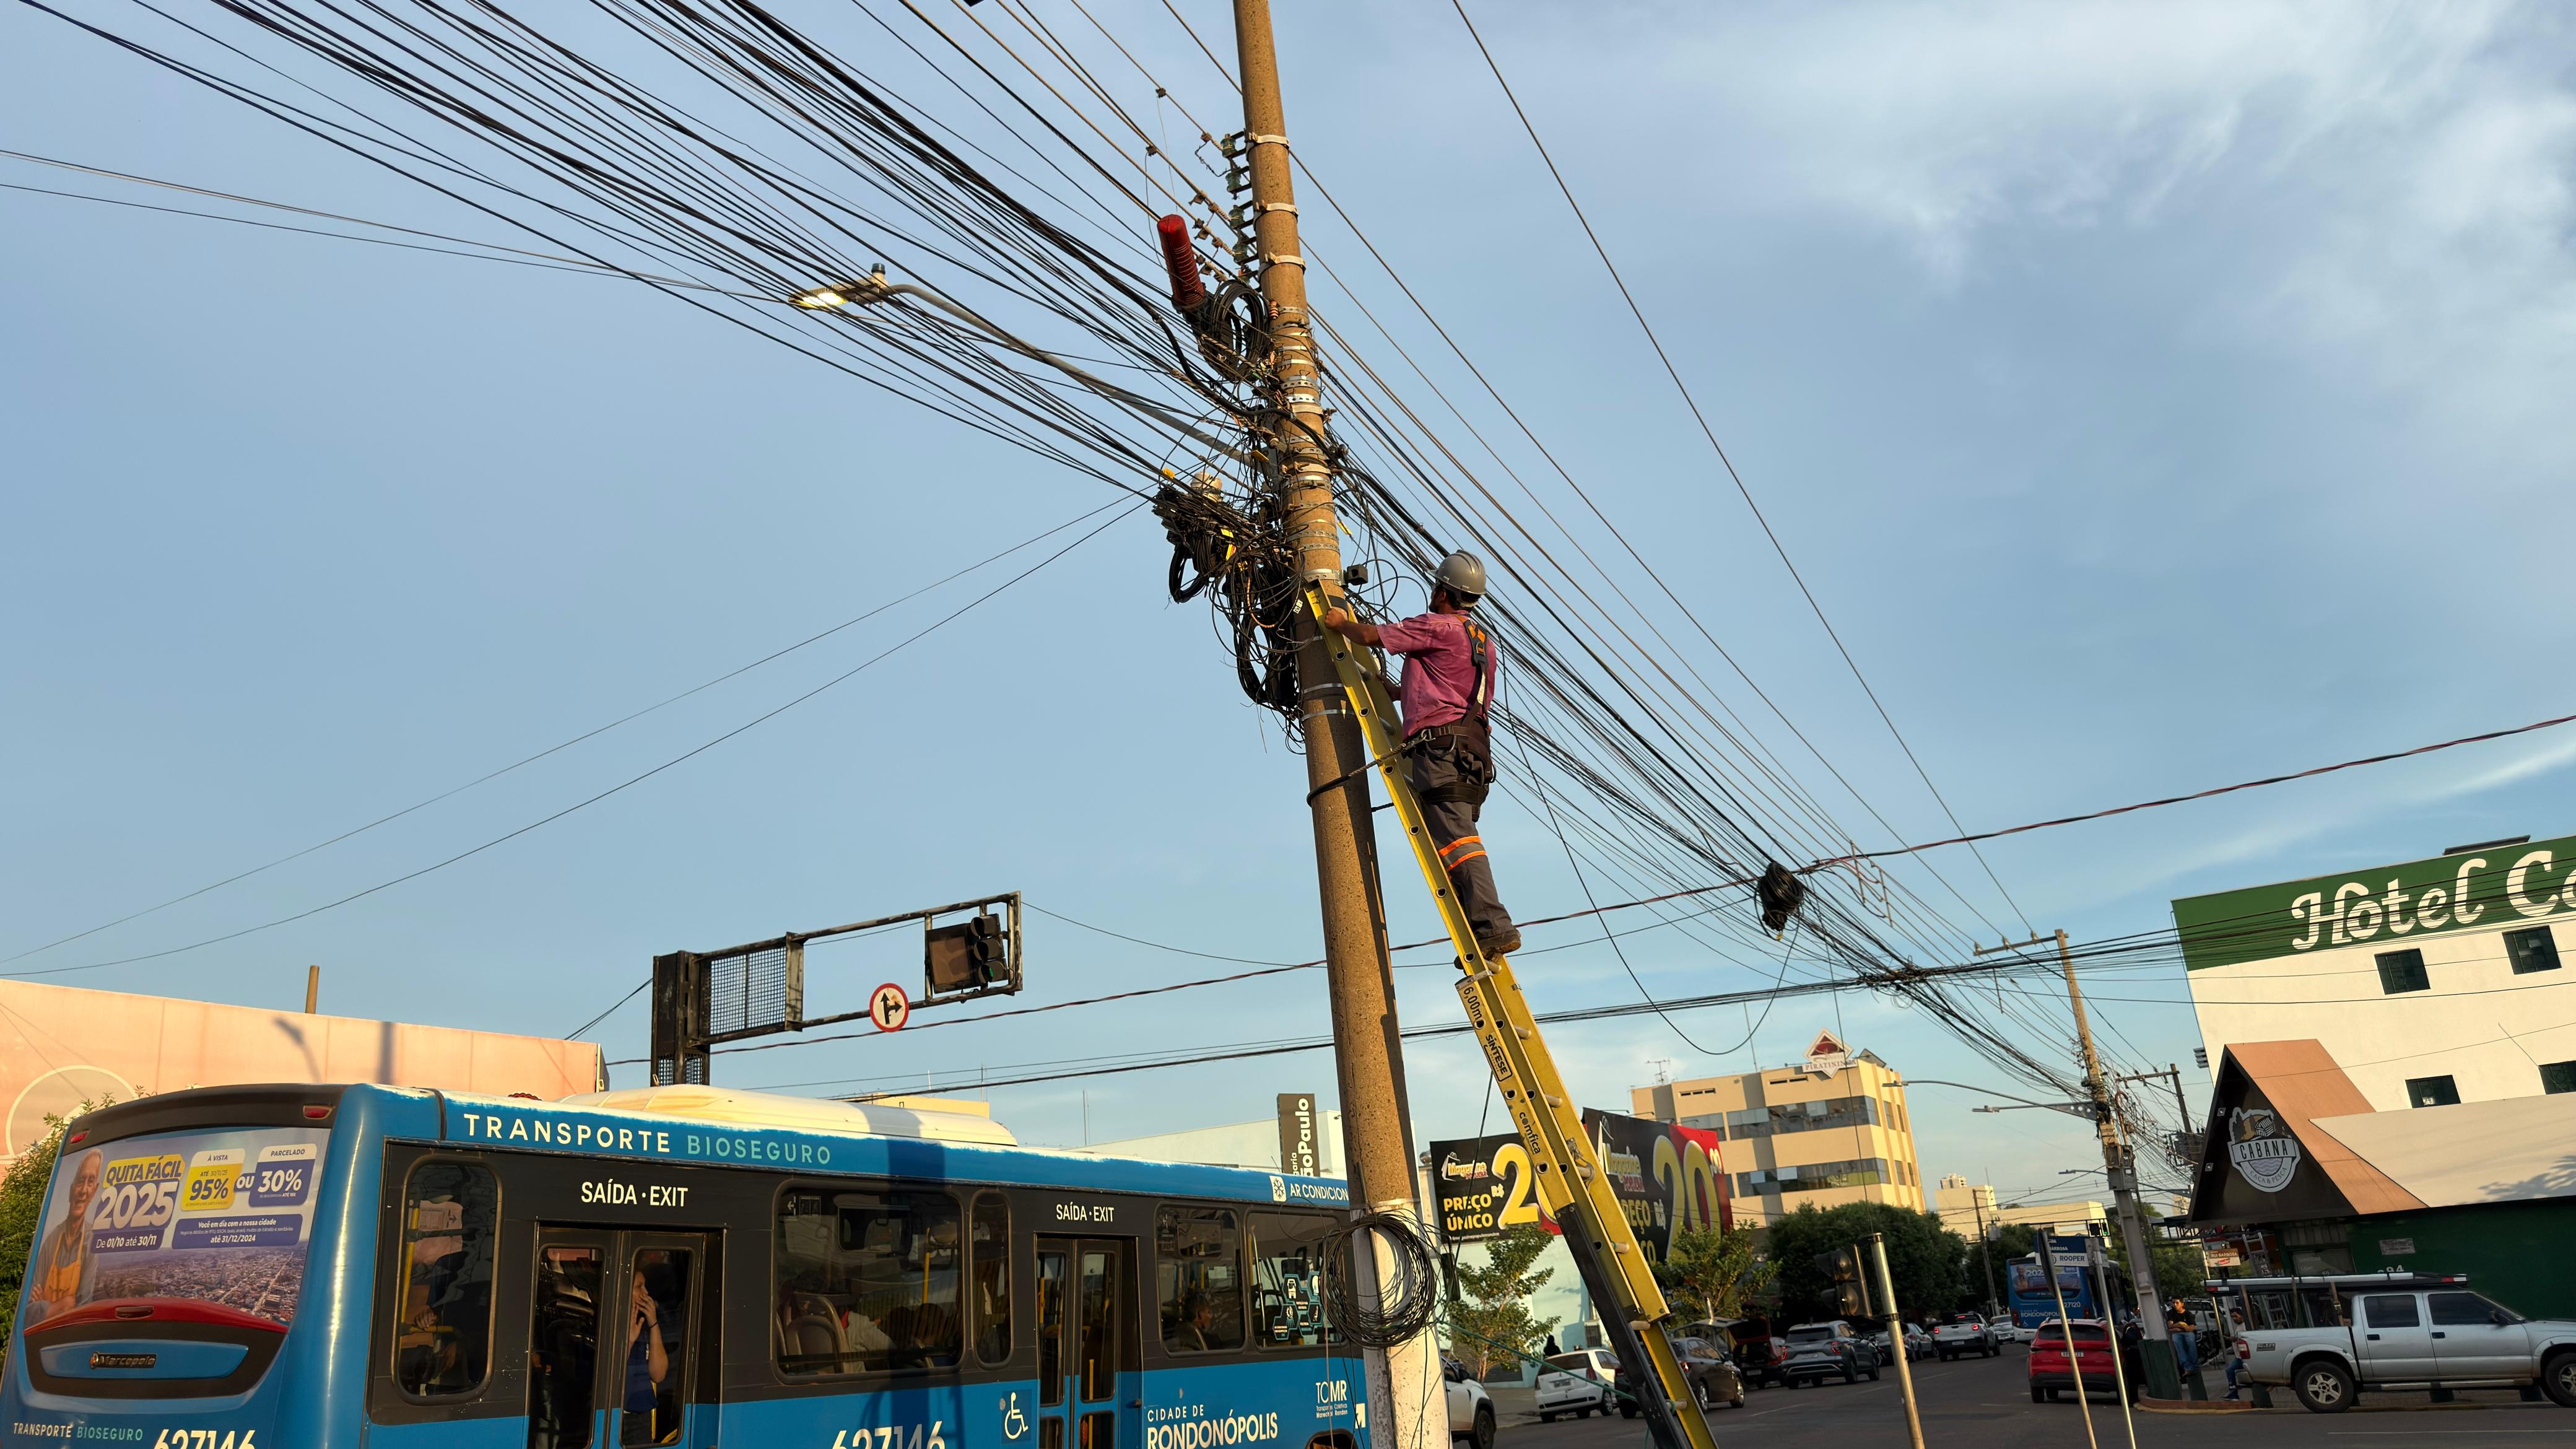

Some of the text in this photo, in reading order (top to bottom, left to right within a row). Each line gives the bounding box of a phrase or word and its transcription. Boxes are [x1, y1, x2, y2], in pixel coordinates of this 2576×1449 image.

[2291, 858, 2487, 949] Hotel
[1464, 986, 1482, 1020] 6,00m
[1486, 1034, 1507, 1074] SÍNTESE
[464, 1113, 831, 1165] TRANSPORTE BIOSEGURO
[2240, 1140, 2288, 1159] CABANA
[271, 1149, 305, 1157] PARCELADO
[1290, 1152, 1300, 1175] garia
[107, 1155, 182, 1186] QUITA FÁCIL
[258, 1168, 302, 1192] 30%
[189, 1178, 228, 1201] 95%
[236, 1175, 255, 1188] OU
[1290, 1183, 1349, 1201] AR CONDICION
[581, 1179, 689, 1207] SAÍDA EXIT
[1443, 1193, 1492, 1212] PREÇO
[93, 1181, 178, 1230] 2025
[1056, 1201, 1114, 1222] SAÍDA EXIT
[198, 1221, 210, 1229] Você
[1447, 1213, 1493, 1231] ÚNICO
[1618, 1199, 1651, 1235] REÇO
[96, 1234, 157, 1248] De 01/10 até 30/11
[211, 1234, 256, 1243] até 31/12/2024
[2377, 1264, 2404, 1273] 94
[1147, 1404, 1204, 1422] CIDADE DE
[14, 1422, 143, 1442] TRANSPORTE BIOSEGURO
[1147, 1409, 1278, 1449] RONDONÓPOLIS
